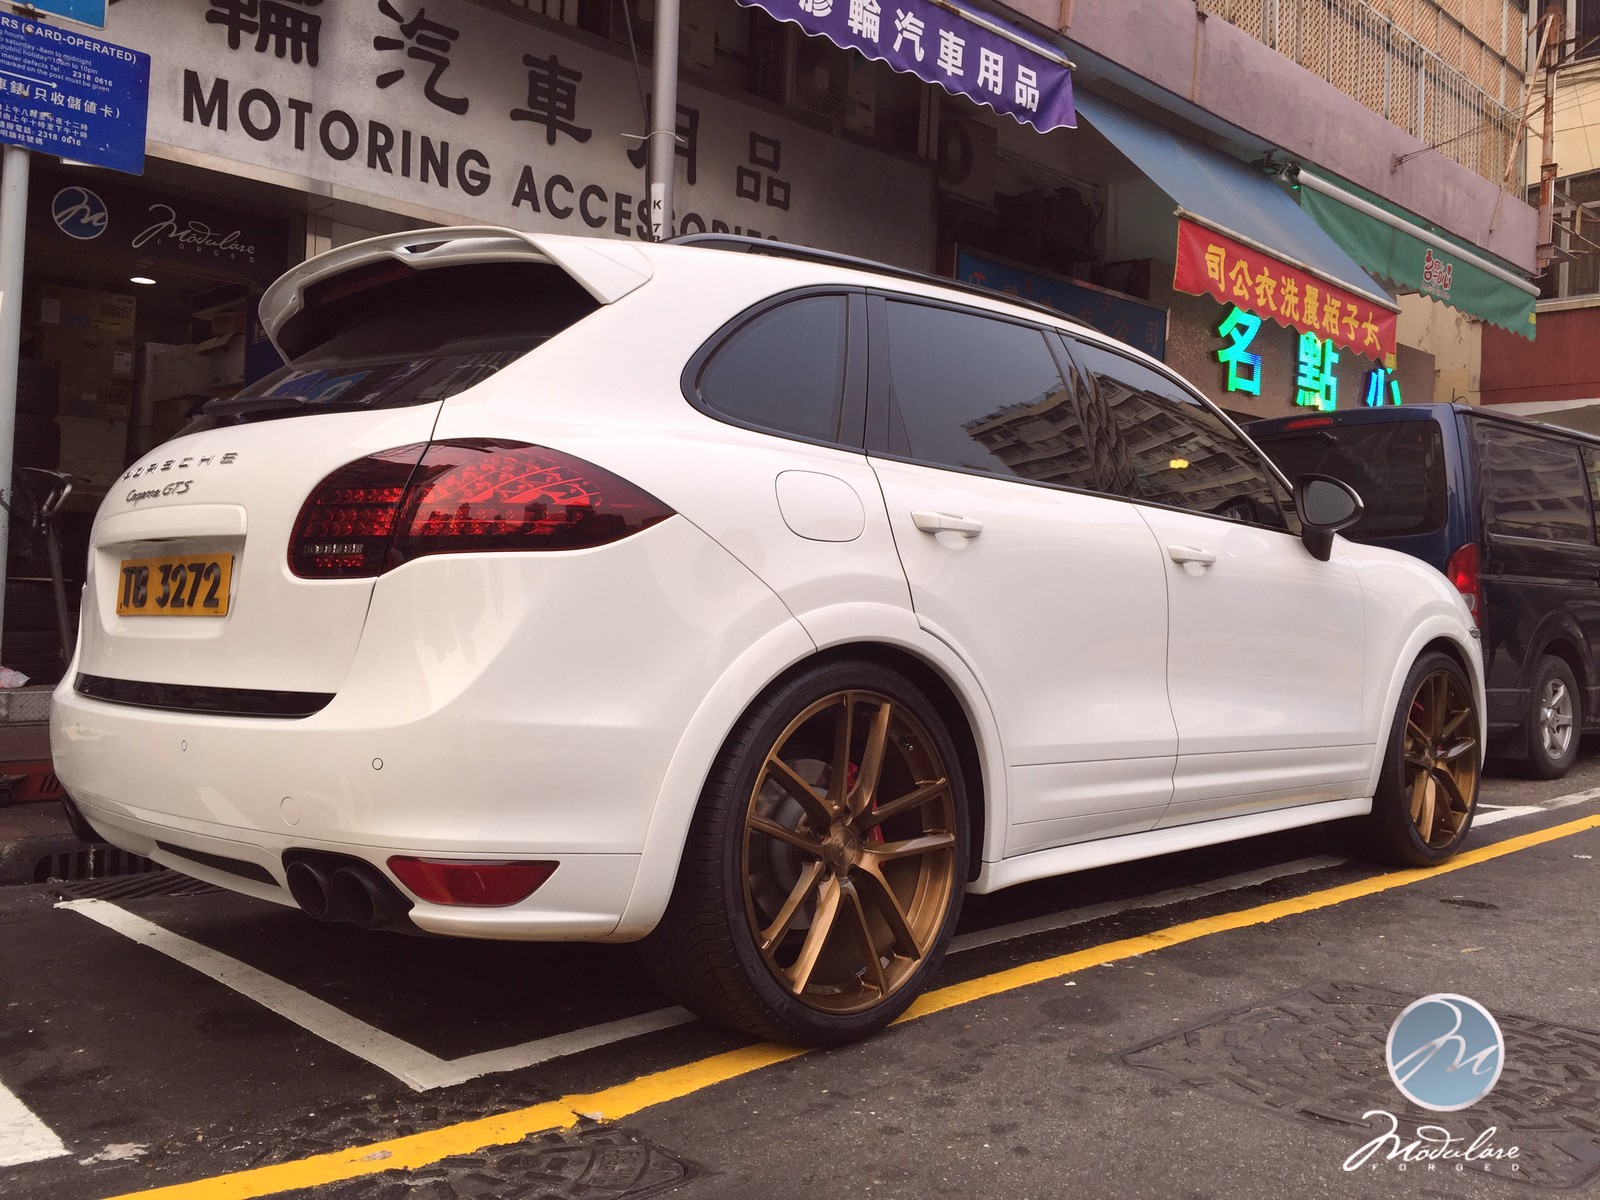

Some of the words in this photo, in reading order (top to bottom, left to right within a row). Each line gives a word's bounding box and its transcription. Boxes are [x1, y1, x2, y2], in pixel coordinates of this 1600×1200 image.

[0, 44, 22, 54] public
[80, 65, 98, 75] 10pm
[1, 52, 22, 62] meter
[23, 58, 48, 69] defects
[72, 70, 91, 81] 2318
[63, 54, 92, 66] midnight
[48, 72, 64, 80] post
[64, 76, 82, 85] must
[82, 80, 91, 88] be
[92, 83, 110, 93] given
[37, 130, 58, 141] 2318
[61, 135, 82, 147] 0616
[183, 69, 491, 196] MOTORING
[511, 165, 780, 242] ACCESO
[653, 200, 662, 210] K
[157, 238, 255, 264] FORGED
[123, 452, 240, 482] PORSCHE
[162, 480, 194, 496] GTS
[122, 565, 149, 609] TB
[155, 561, 222, 609] 3272
